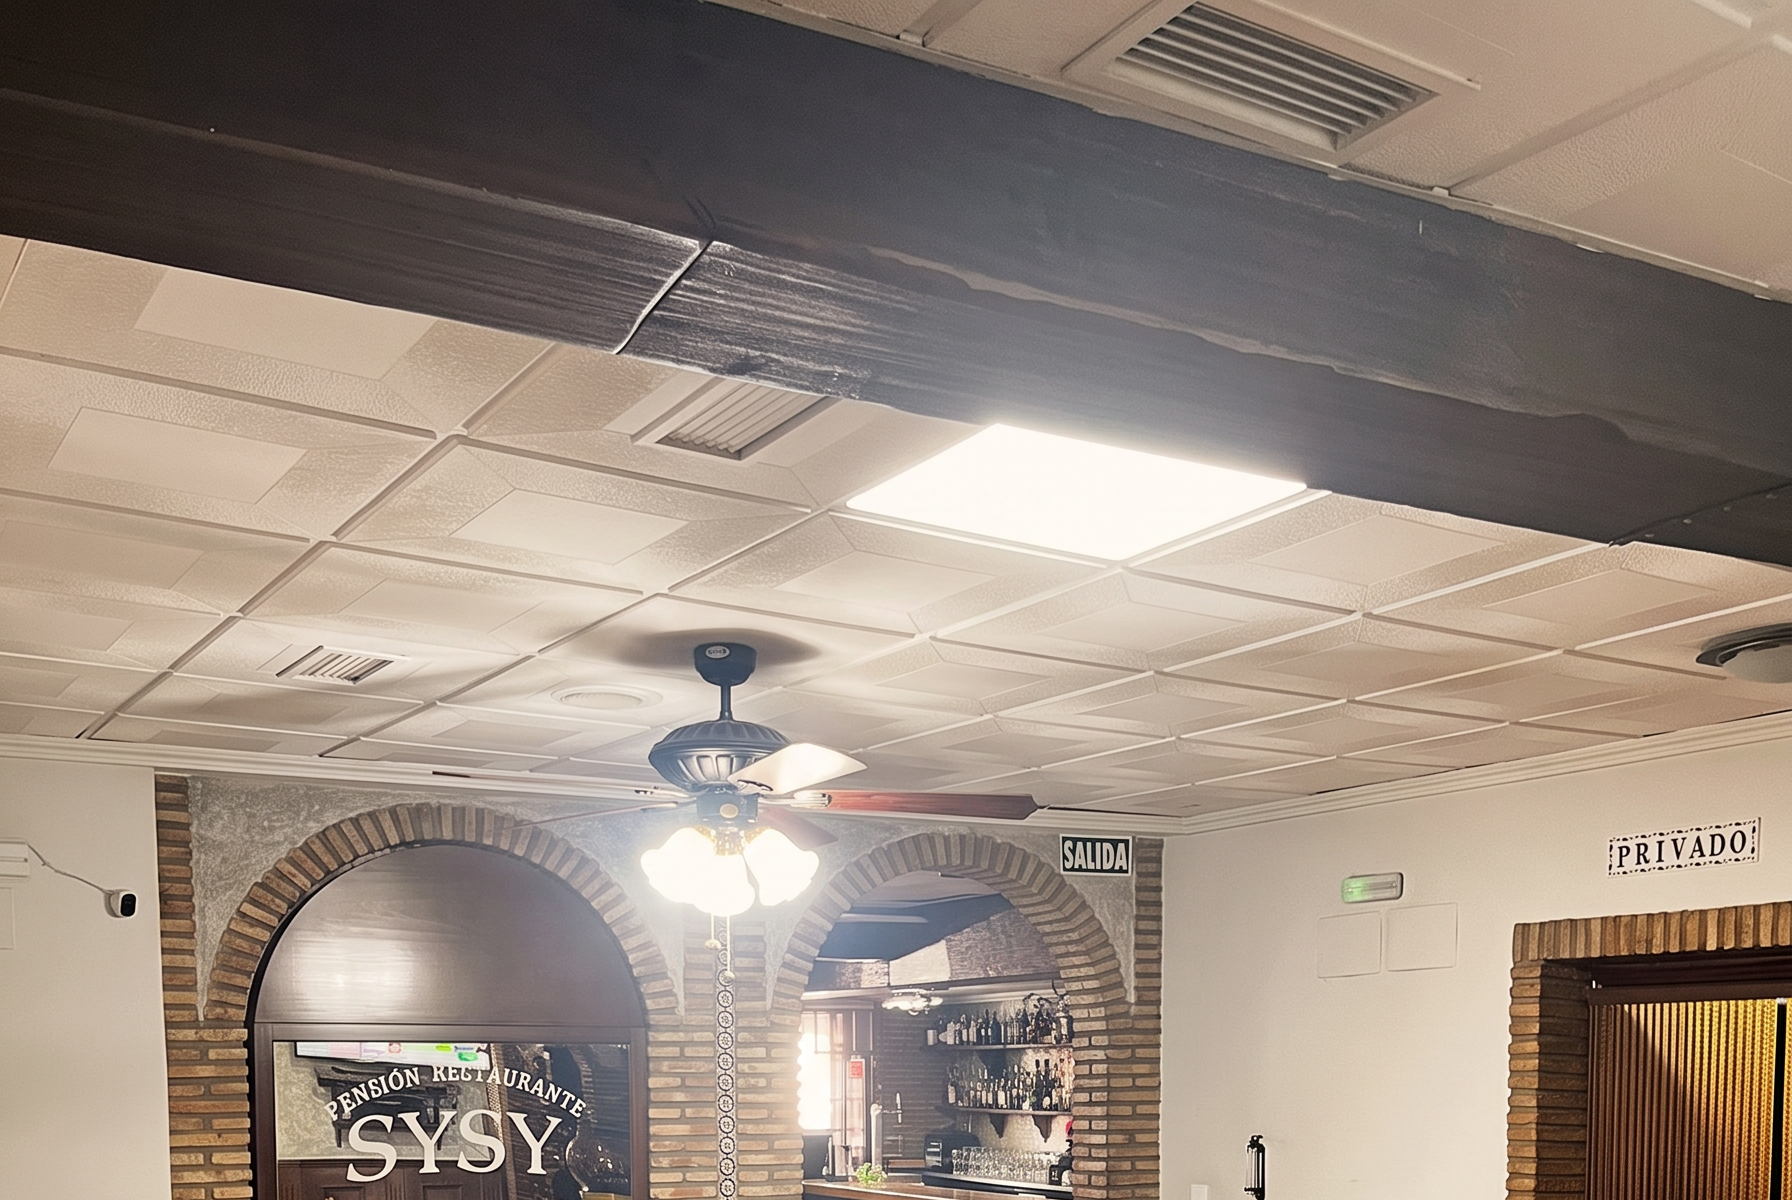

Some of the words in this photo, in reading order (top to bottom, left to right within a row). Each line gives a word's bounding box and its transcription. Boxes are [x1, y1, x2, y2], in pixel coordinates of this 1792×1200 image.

[1063, 839, 1128, 871] SALIDA
[1616, 829, 1747, 868] PRIVADO
[324, 1066, 420, 1121] PENSIÓN
[346, 1109, 563, 1183] SYSY
